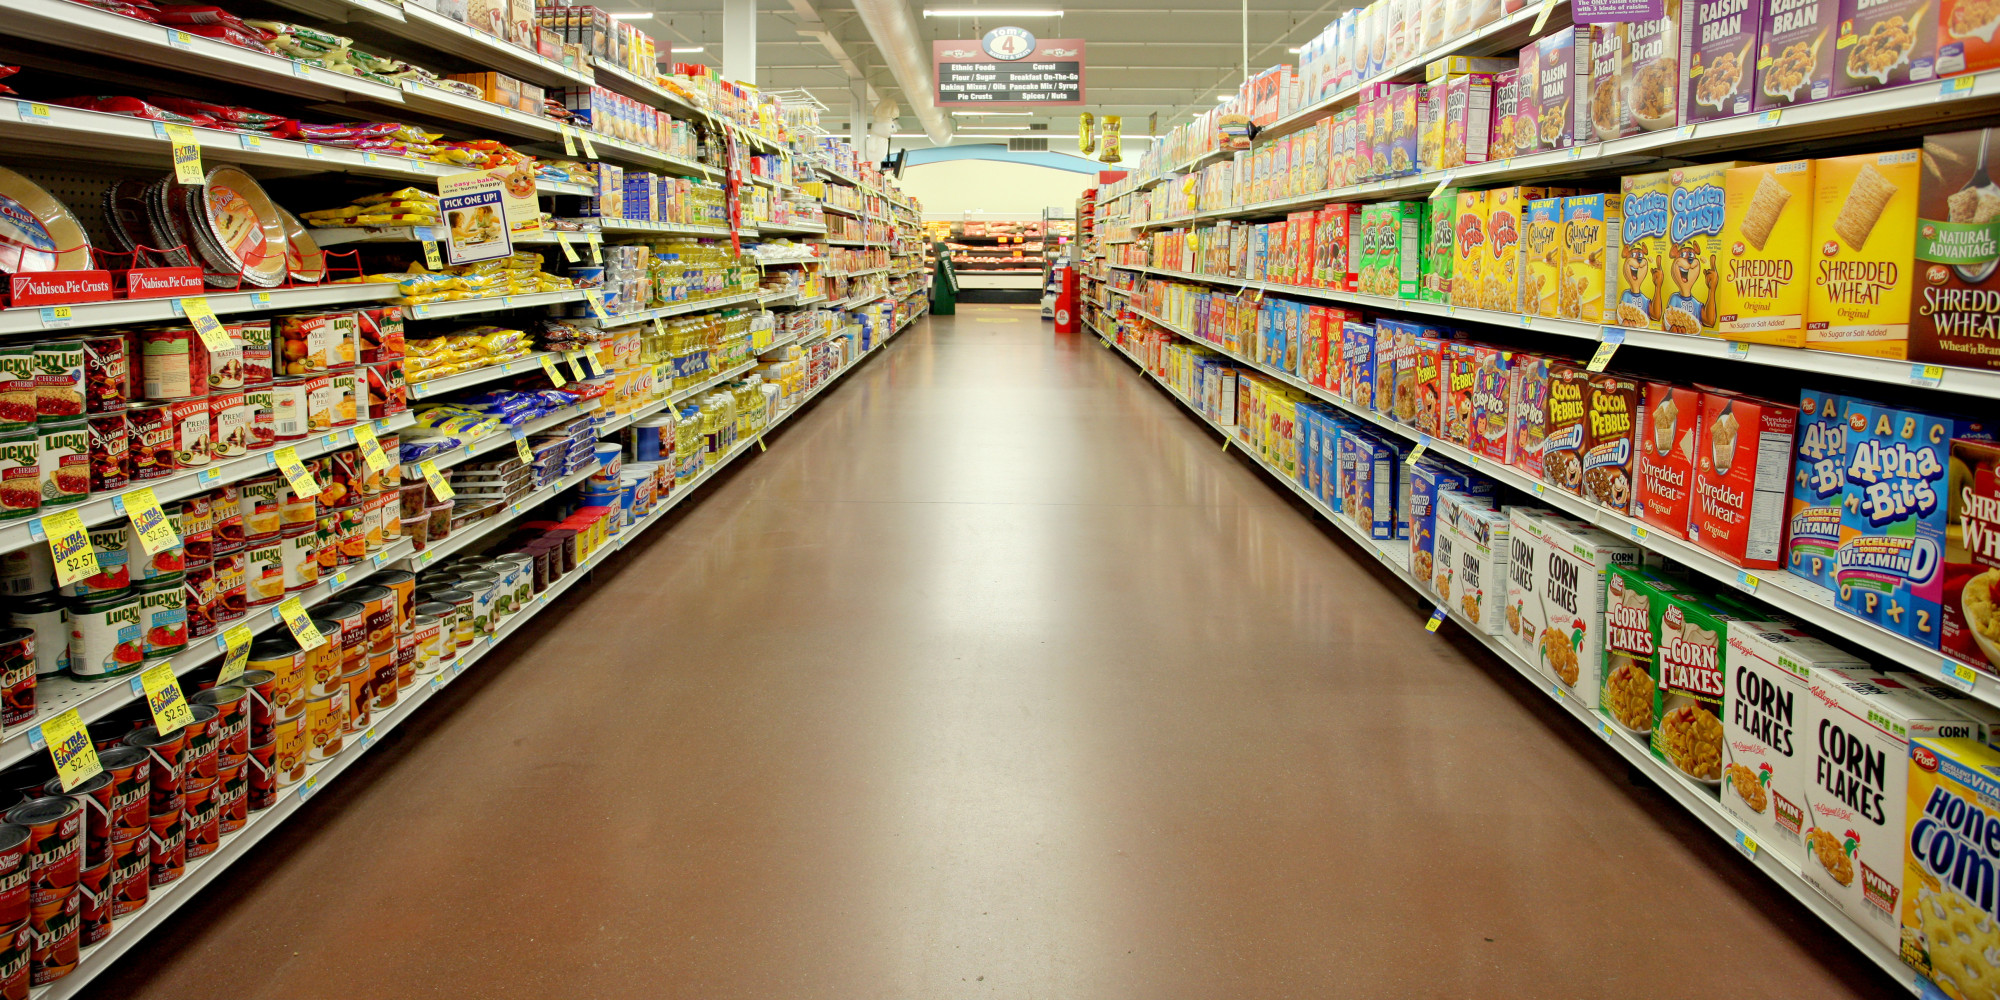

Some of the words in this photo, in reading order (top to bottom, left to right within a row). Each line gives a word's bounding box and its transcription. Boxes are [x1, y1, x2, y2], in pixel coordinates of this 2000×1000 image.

[1702, 14, 1742, 44] BRAN
[1772, 4, 1817, 36] BRAN
[1002, 36, 1014, 54] 4
[1592, 34, 1622, 60] Raisin
[1631, 39, 1663, 62] Bran
[1542, 62, 1567, 85] RAISIN
[1594, 56, 1614, 78] Bran
[940, 84, 964, 92] Baking
[976, 74, 996, 82] Sugar
[1010, 82, 1038, 90] Pancake
[1059, 82, 1078, 91] Syrup
[1022, 92, 1046, 100] Spices
[1543, 80, 1564, 100] BRAN
[33, 104, 46, 116] 7.13
[175, 145, 196, 158] EXTRA
[176, 152, 199, 165] SAVINGS!
[183, 165, 200, 176] $3.90
[480, 180, 502, 189] happy!
[444, 199, 463, 209] PICK
[464, 196, 483, 206] ONE
[484, 193, 498, 202] UP!
[1531, 200, 1555, 210] NEW!
[1568, 197, 1598, 208] NEW!
[1624, 190, 1668, 217] Golden
[1672, 184, 1725, 213] Golden
[0, 204, 35, 224] Crust
[1563, 221, 1600, 246] CRUNCHY
[1623, 208, 1667, 244] Crisp
[1671, 205, 1724, 245] Crisp
[1939, 229, 1991, 244] NATURAL
[1823, 242, 1838, 255] Post
[1929, 241, 1996, 258] ADVANTAGE
[1727, 258, 1793, 282] SHREDDED
[1816, 260, 1898, 286] SHREDDED
[1928, 269, 1946, 281] Post
[28, 282, 64, 296] Nabisco
[66, 281, 80, 293] Pie
[82, 280, 108, 292] Crusts
[141, 277, 168, 290] Nabisco
[169, 276, 180, 288] Pie
[180, 276, 202, 287] Crusts
[1736, 278, 1789, 298] WHEAT
[1827, 282, 1894, 305] WHEAT
[1744, 302, 1771, 313] Original
[1838, 307, 1870, 321] Original
[193, 316, 213, 329] EXTRA
[1736, 321, 1750, 330] Sugar
[1757, 320, 1766, 328] Salt
[1768, 318, 1785, 328] Added
[1827, 330, 1846, 340] Sugar
[1853, 330, 1864, 338] Salt
[1866, 328, 1888, 338] Added
[1925, 366, 1938, 376] 4.19
[1552, 380, 1581, 400] COCOA
[1550, 398, 1584, 424] PEBBLES
[1592, 390, 1626, 412] COCOA
[1590, 410, 1630, 438] PEBBLES
[1762, 414, 1792, 424] Shredded
[1767, 420, 1788, 428] Wheat
[1850, 416, 1864, 428] Post
[46, 434, 83, 450] LUCKY
[1640, 456, 1684, 486] Shredded
[1848, 440, 1942, 482] Alpha
[243, 484, 275, 498] LUCKY
[1646, 476, 1676, 500] Wheat
[1696, 476, 1744, 509] Shredded
[1648, 498, 1672, 516] Original
[1863, 478, 1936, 520] -Bits
[134, 507, 158, 528] EXTRA
[1702, 496, 1735, 525] Wheat
[138, 511, 164, 536] SAVINGS!
[1704, 520, 1730, 540] Original
[53, 530, 82, 555] EXTRA
[147, 527, 169, 542] $2.55
[1852, 537, 1913, 549] EXCELLENT
[56, 535, 88, 564] SAVINGS!
[250, 549, 280, 562] LUCKY
[1512, 536, 1534, 571] CORN
[1612, 552, 1634, 562] CORN
[1840, 550, 1910, 572] VITAMIN
[1908, 537, 1936, 580] D
[66, 553, 94, 572] $2.57
[1464, 552, 1480, 570] CORN
[1462, 566, 1480, 588] FLAKES
[1510, 560, 1532, 592] FLAKES
[1549, 552, 1578, 592] CORN
[141, 593, 172, 610] LUCKY
[1548, 578, 1577, 614] FLAKES
[106, 606, 140, 626] LUCKY
[1614, 603, 1648, 631] CORN
[1605, 612, 1654, 655] FLAKES
[1672, 637, 1716, 669] CORN
[1728, 638, 1754, 657] Kellogg's
[1658, 646, 1724, 696] FLAKES
[1957, 668, 1972, 680] 2.89
[150, 684, 175, 707] EXTRA
[154, 688, 180, 715] SAVINGS!
[1736, 666, 1794, 727] CORN
[1809, 684, 1838, 709] Kellogg's
[164, 704, 188, 722] $2.57
[1734, 698, 1794, 758] FLAKES
[1938, 726, 1970, 738] CORN
[54, 731, 82, 757] EXTRA
[57, 736, 88, 769] SAVINGS!
[70, 750, 95, 772] $2.17
[1819, 718, 1886, 793] CORN
[1915, 751, 1936, 766] Post
[1817, 755, 1886, 826] FLAKES
[1776, 796, 1800, 819] WIN
[1864, 869, 1892, 896] WIN
